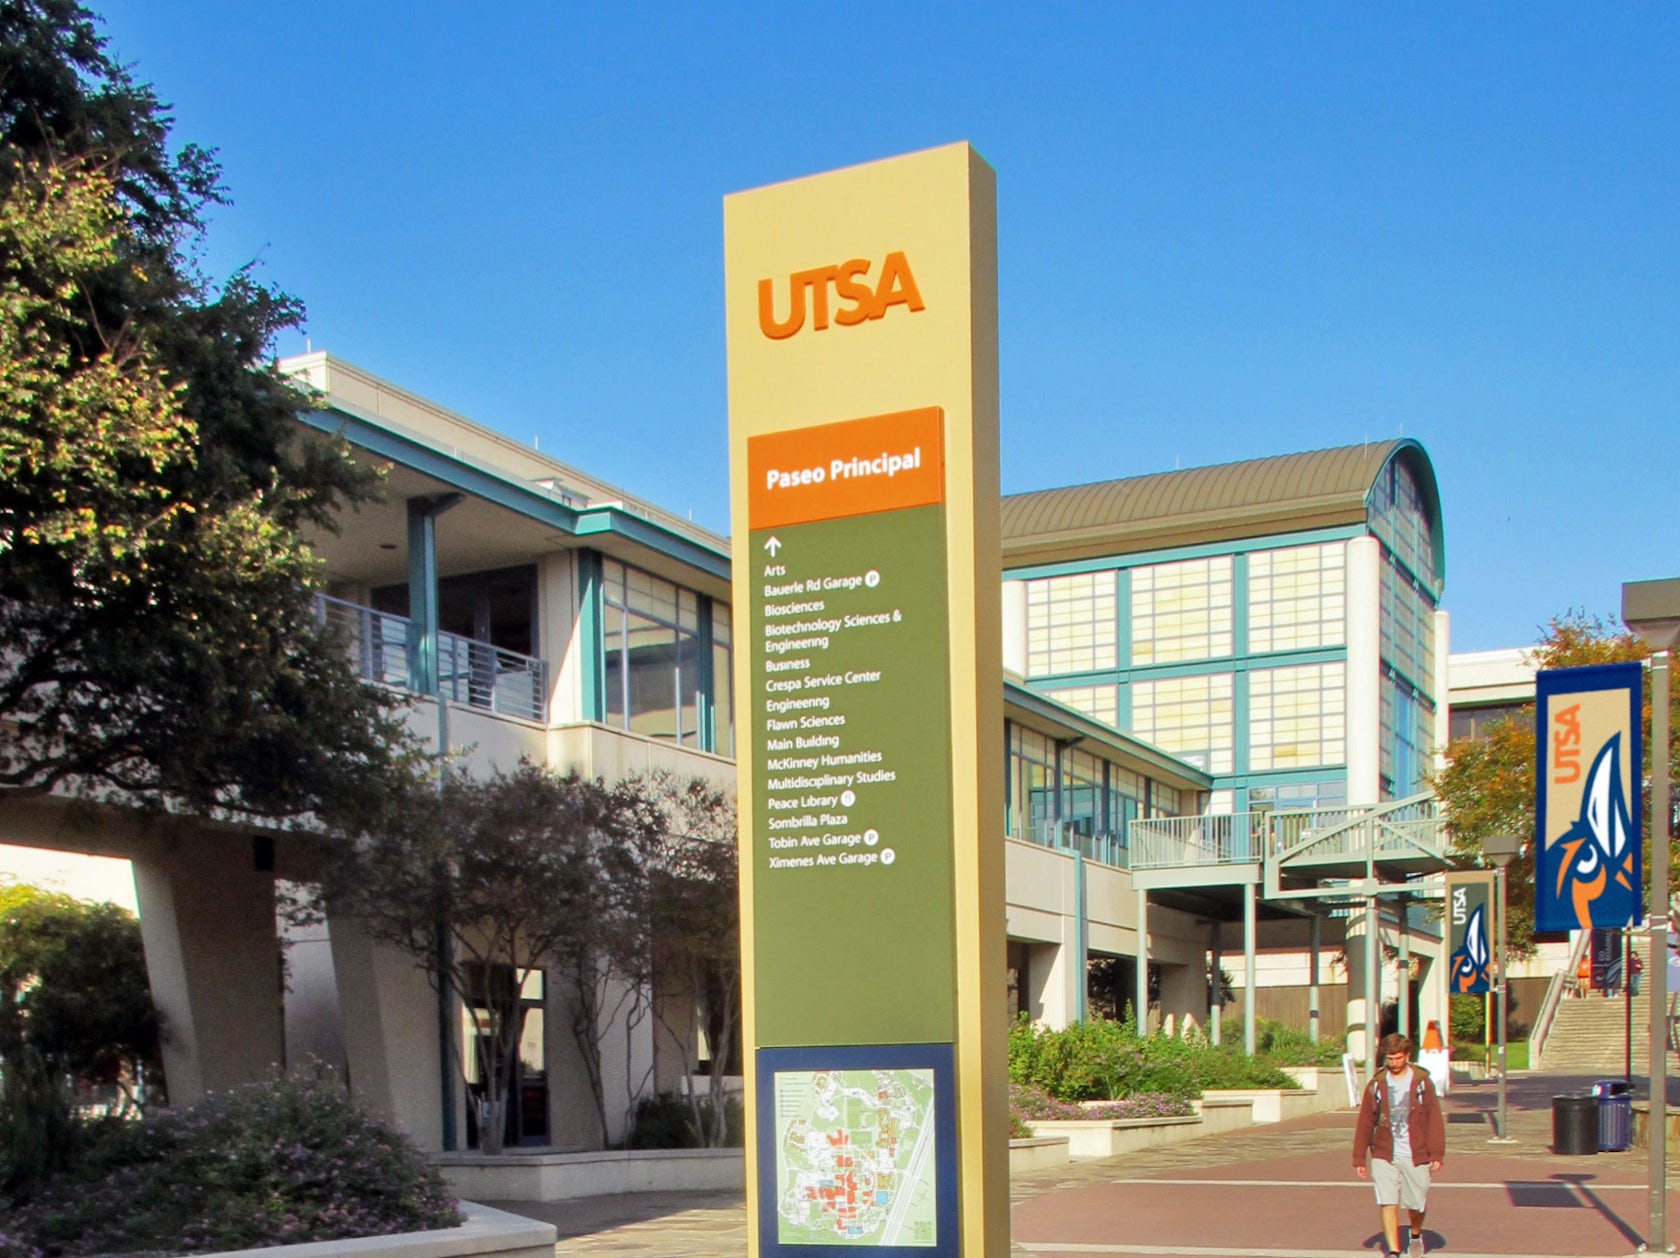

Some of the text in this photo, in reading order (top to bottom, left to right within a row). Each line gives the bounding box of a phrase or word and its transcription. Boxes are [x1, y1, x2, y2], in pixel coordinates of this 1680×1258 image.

[757, 250, 926, 341] UTSA
[766, 446, 921, 490] Paseo Principal
[764, 565, 786, 577] Arts
[764, 581, 803, 597] Bauerle
[806, 578, 821, 592] Rd
[823, 576, 862, 590] Garage
[765, 600, 825, 617] Biosciences
[765, 609, 902, 637] Biotechnology Sciences &
[765, 637, 829, 654] Engineering
[766, 659, 810, 673] Business
[766, 671, 881, 692] Crespa Service Center
[766, 696, 829, 713] Engineering
[767, 715, 845, 731] Flawn Sciences
[767, 736, 839, 751] Main Building
[1554, 703, 1581, 785] UTSA
[768, 751, 882, 771] McKinney Humanities
[768, 770, 896, 790] Multidisciplinary Studies
[768, 796, 838, 810] Peace Library
[769, 814, 847, 830] Sombrilla Plaza
[769, 836, 798, 849] Tobin
[801, 835, 820, 847] Ave
[823, 833, 861, 846] Garage
[769, 856, 813, 868] Ximenes
[816, 854, 836, 865] Ave
[839, 852, 877, 866] Garage
[1453, 887, 1467, 925] UTSA
